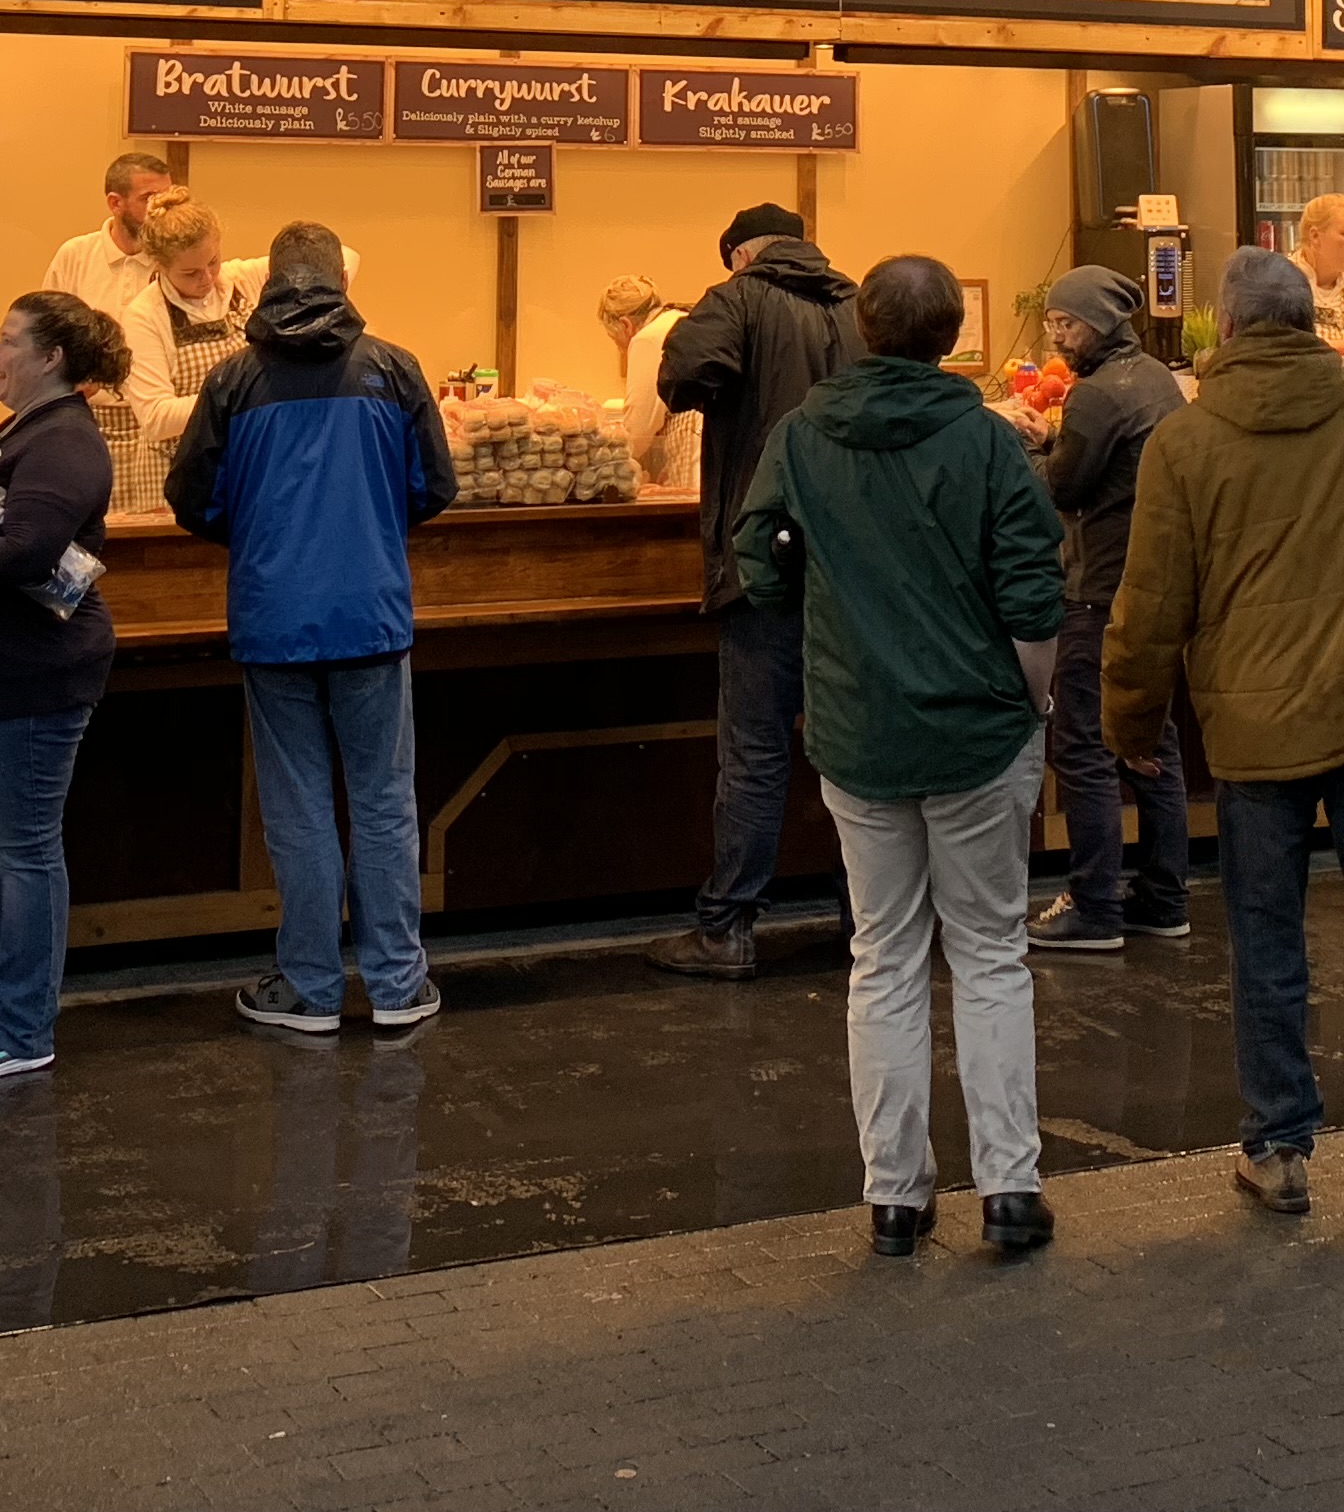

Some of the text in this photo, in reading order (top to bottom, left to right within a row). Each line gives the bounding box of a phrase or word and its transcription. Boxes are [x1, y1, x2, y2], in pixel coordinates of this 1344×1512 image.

[156, 59, 358, 101] Bratwurst
[421, 68, 597, 111] Currywurst
[662, 77, 830, 116] Krakauer
[208, 101, 309, 117] White sausage
[199, 115, 315, 131] Deliciously plain
[402, 110, 621, 128] Deliciously plain with a curry ketchup
[713, 115, 782, 128] red sausage
[465, 124, 560, 138] & Slightly spiced
[699, 126, 795, 141] Slightly smoked
[496, 149, 537, 169] All of our
[497, 165, 536, 178] German
[486, 175, 547, 192] Sausages are
